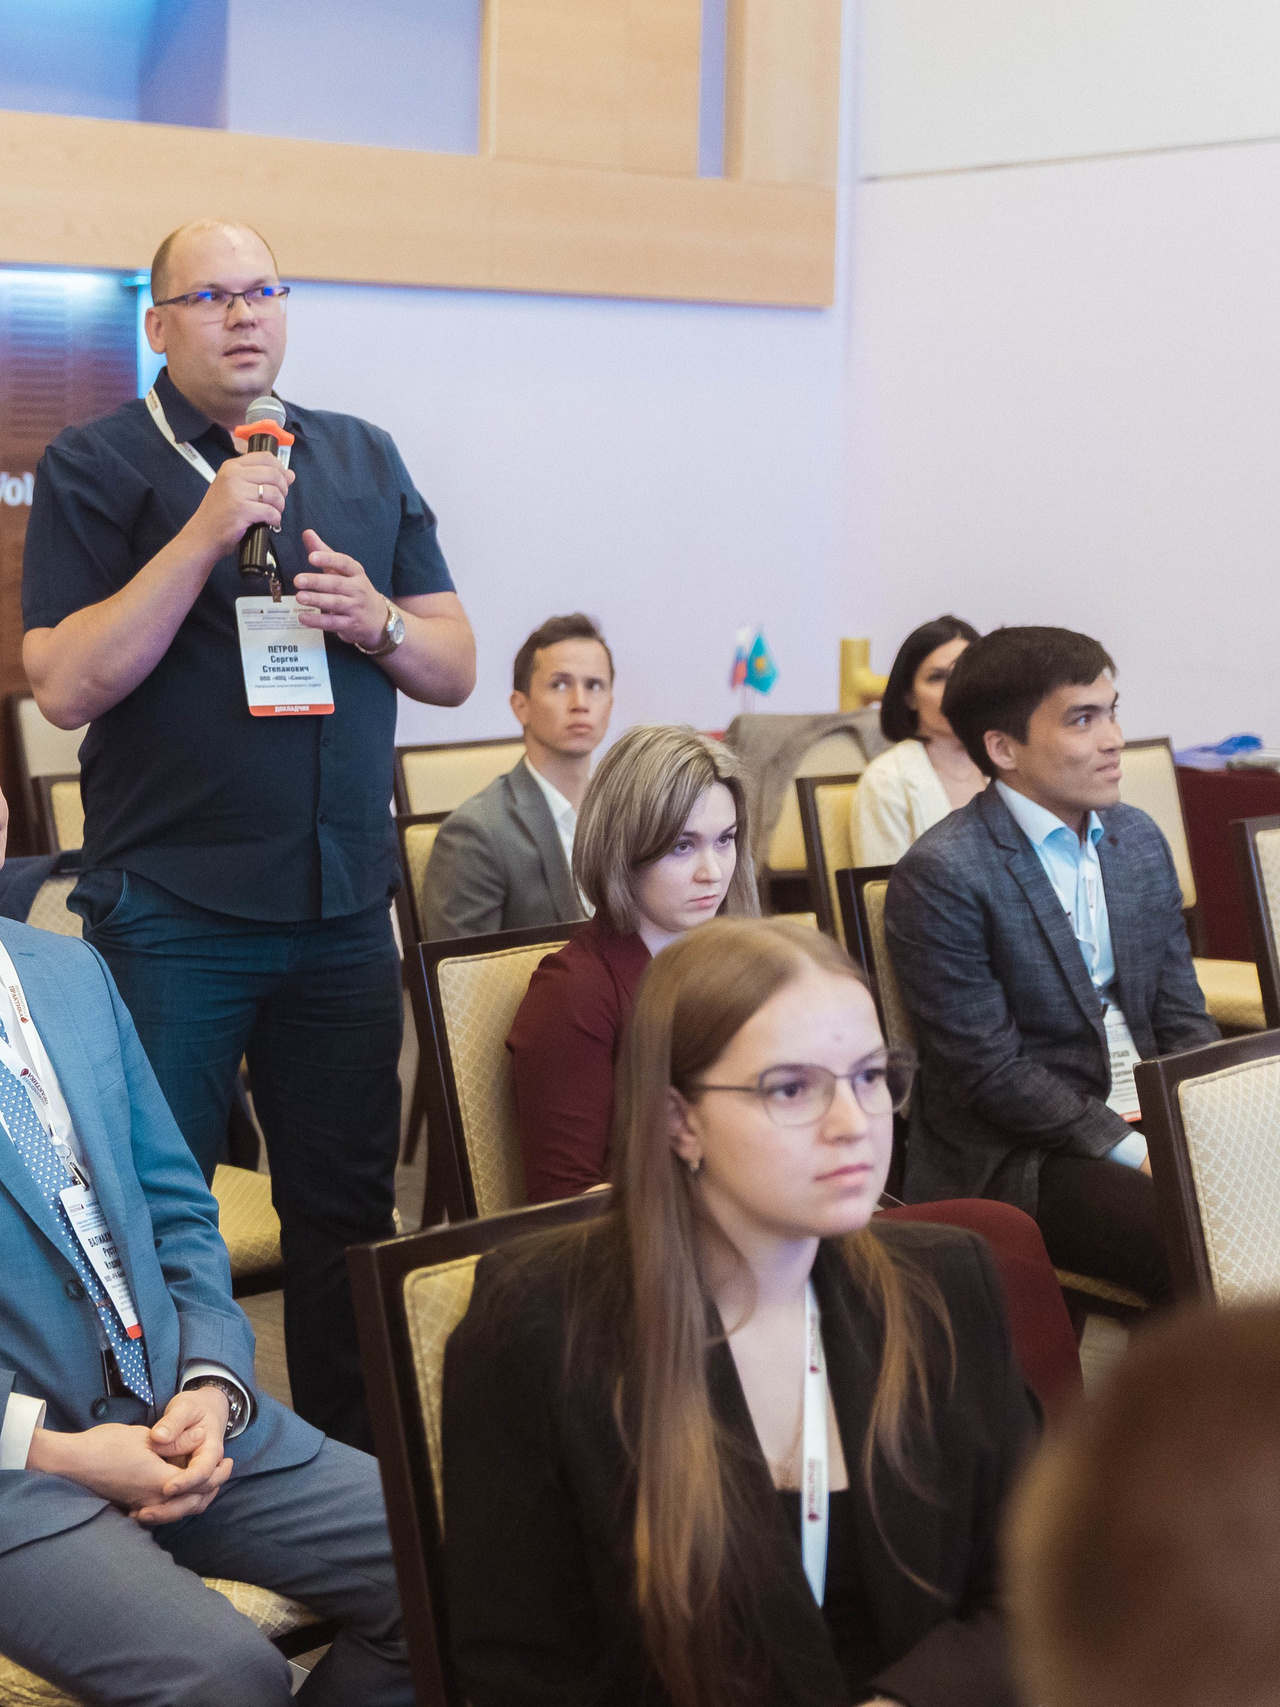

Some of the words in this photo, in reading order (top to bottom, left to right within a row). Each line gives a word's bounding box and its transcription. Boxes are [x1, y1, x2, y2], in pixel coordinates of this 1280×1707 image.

[268, 645, 299, 653] ПЕТРОВ
[270, 655, 299, 664] Сергей
[262, 665, 309, 673] Степанович
[8, 985, 24, 1017] ПРАКТИКА
[27, 1072, 49, 1105] ПРАКТИКА
